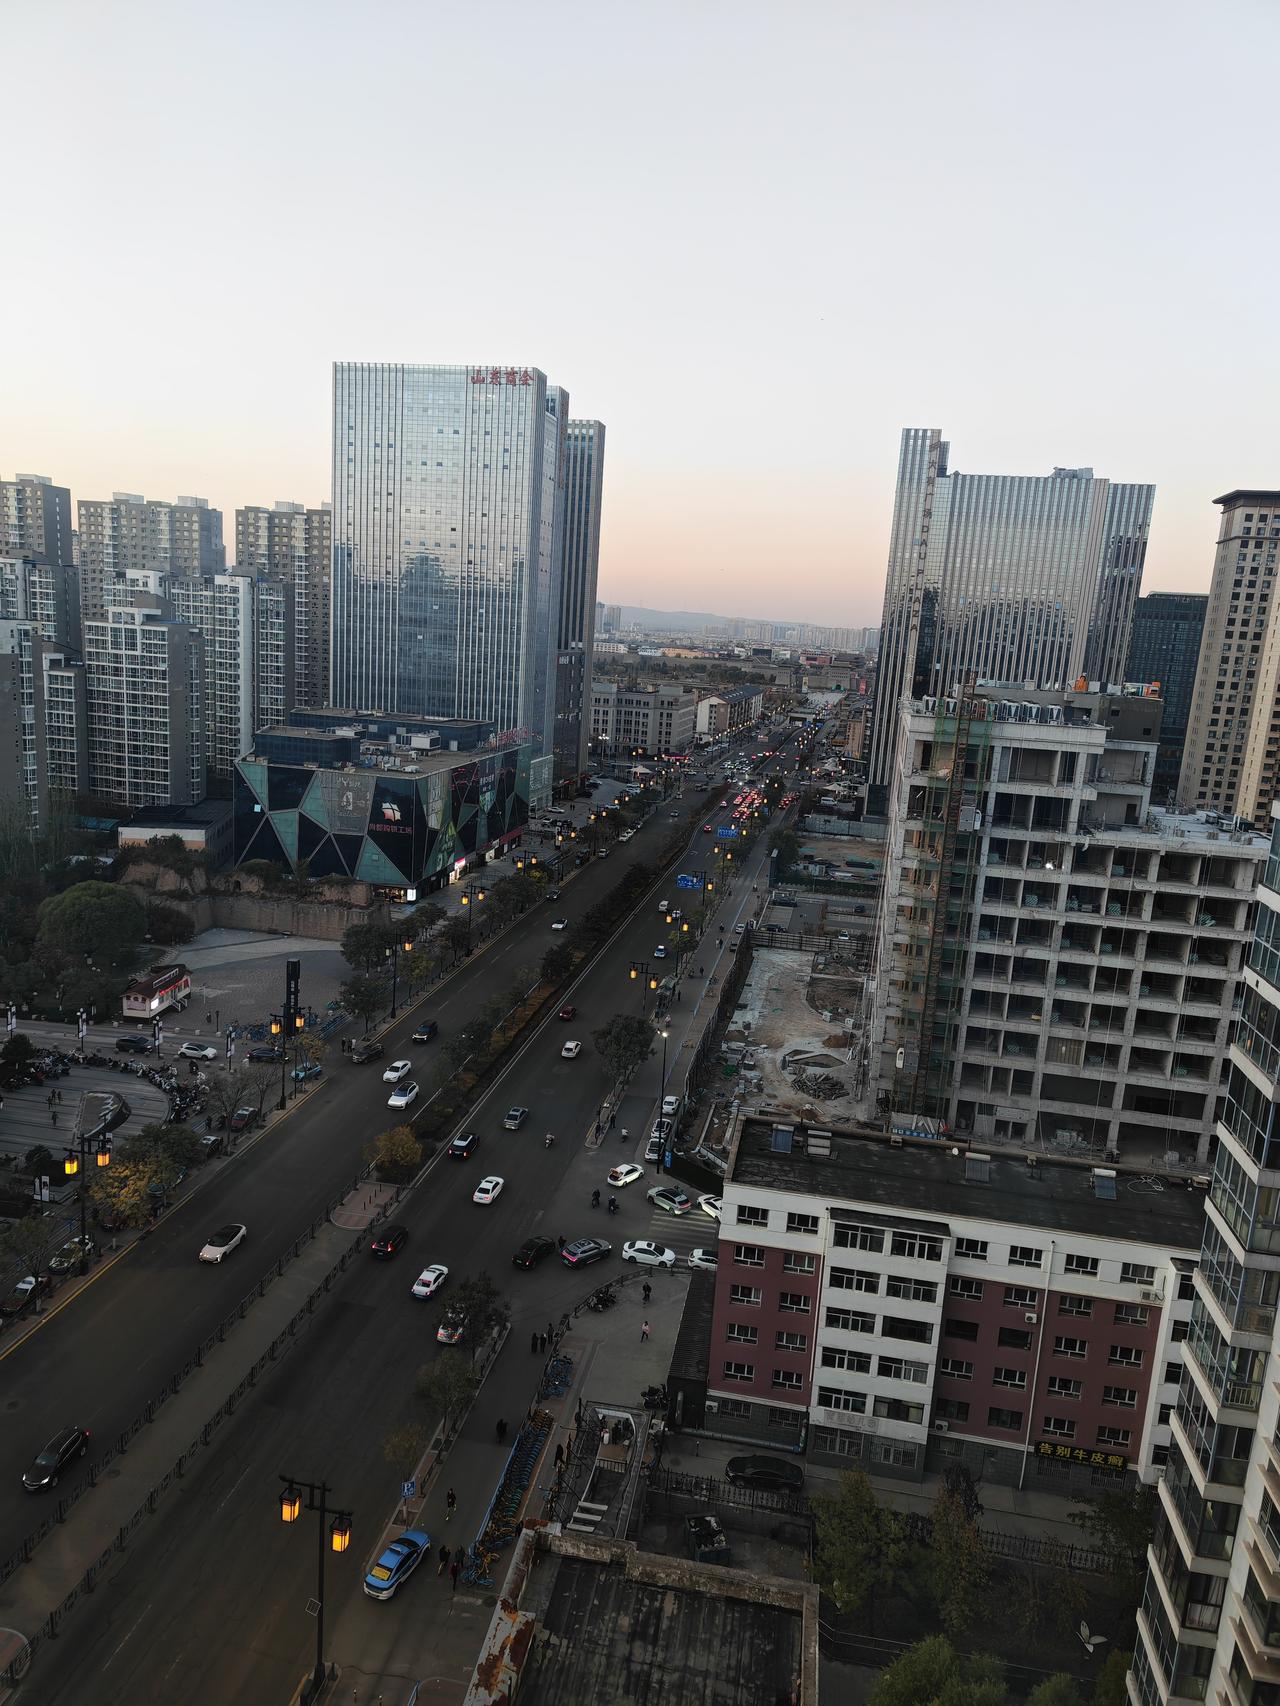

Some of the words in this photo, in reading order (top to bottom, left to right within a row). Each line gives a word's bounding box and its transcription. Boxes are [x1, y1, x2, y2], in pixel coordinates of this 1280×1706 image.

[1039, 1442, 1124, 1467] 告别牛皮癣
